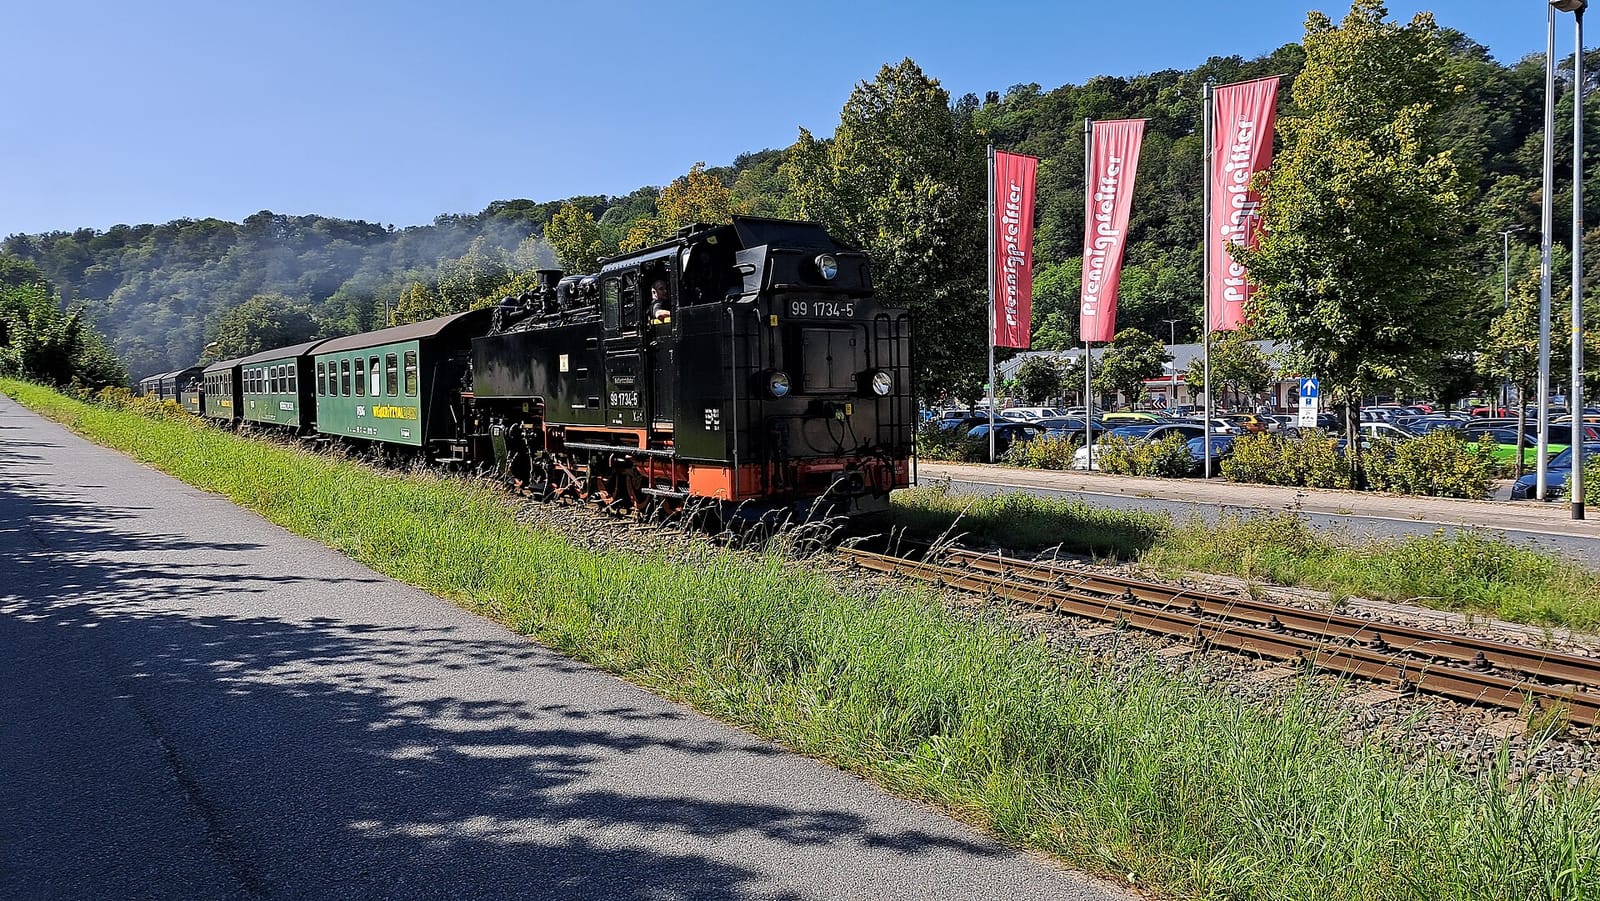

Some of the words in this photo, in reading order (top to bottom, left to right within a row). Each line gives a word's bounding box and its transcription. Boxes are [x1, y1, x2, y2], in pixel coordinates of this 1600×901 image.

[1002, 183, 1025, 326] Pfennigpfeiffer
[1082, 155, 1121, 316] Pfennigpfeiffer
[1221, 119, 1260, 302] Pfenigpfeiffer
[792, 301, 808, 316] 99
[812, 302, 854, 317] 1734-5
[610, 392, 618, 406] 99
[618, 392, 638, 406] 1734-5
